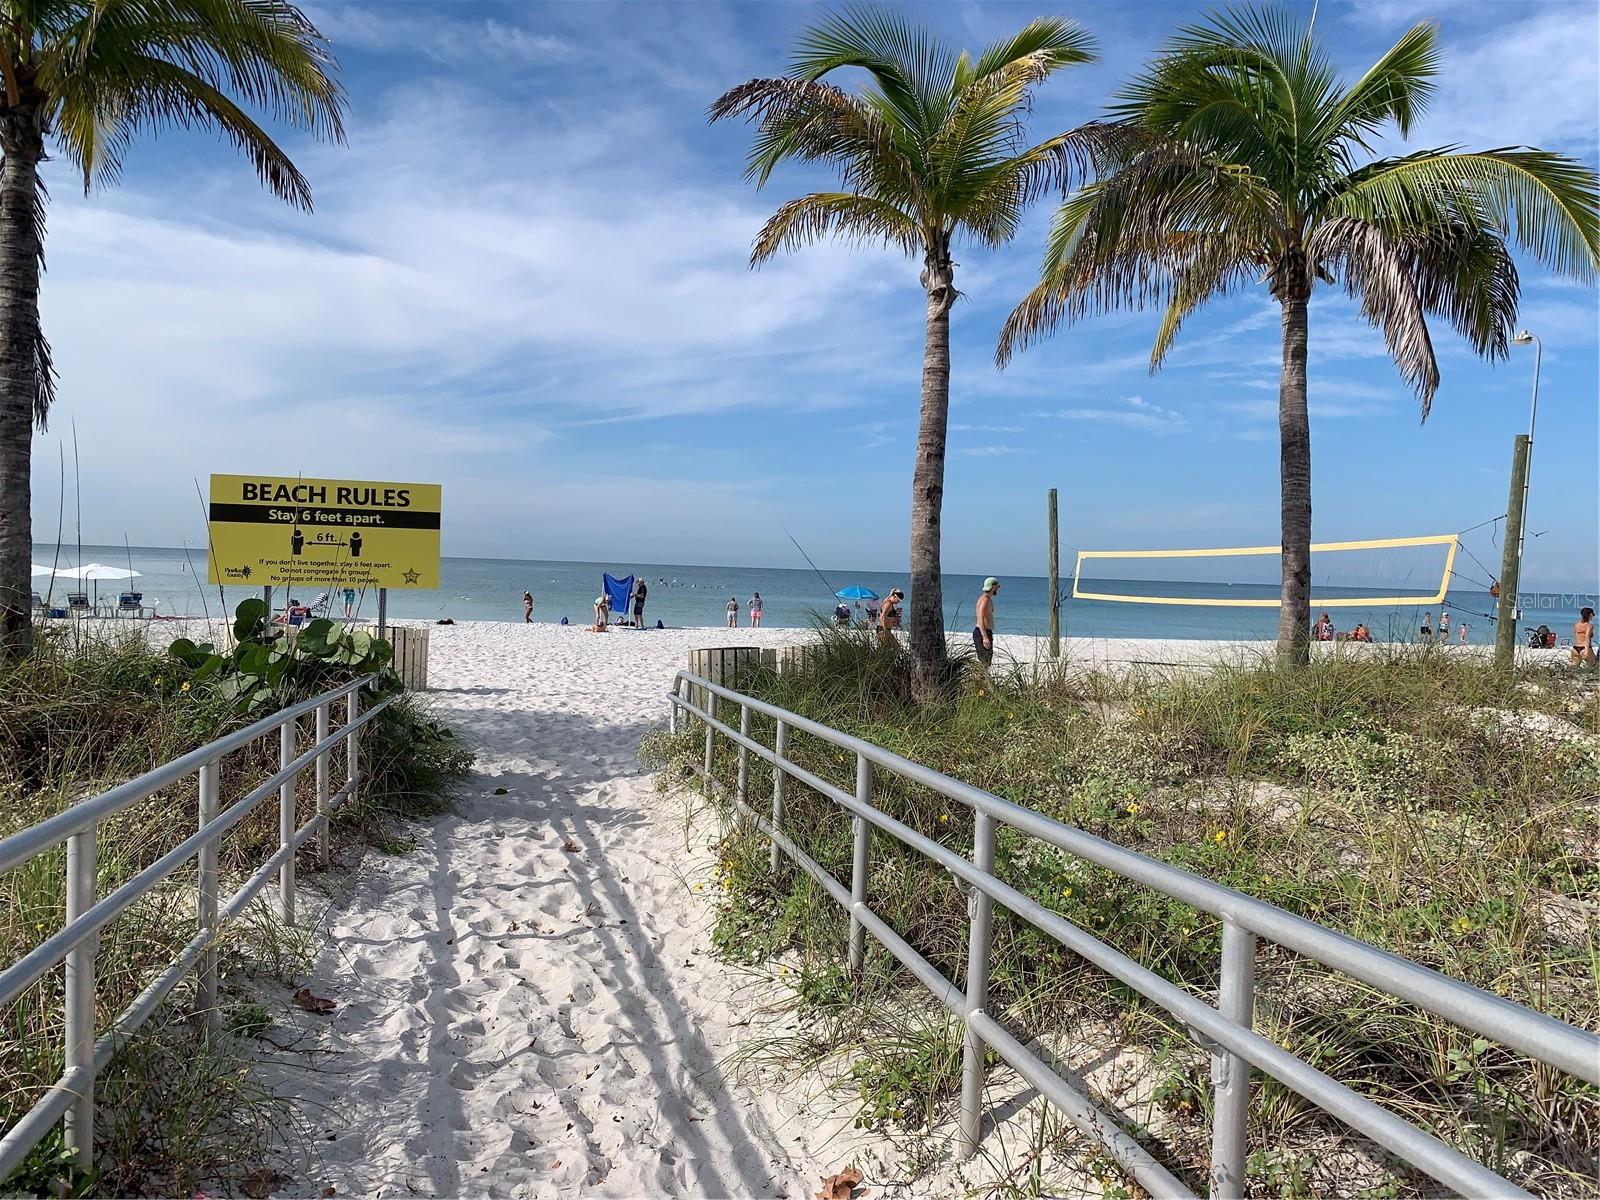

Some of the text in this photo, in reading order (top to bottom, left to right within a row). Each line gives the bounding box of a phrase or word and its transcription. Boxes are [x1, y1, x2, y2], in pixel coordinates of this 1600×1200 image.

[242, 483, 411, 507] BEACH RULES
[268, 509, 385, 525] Stay 6 feet apart.
[316, 532, 338, 542] 6 ft.
